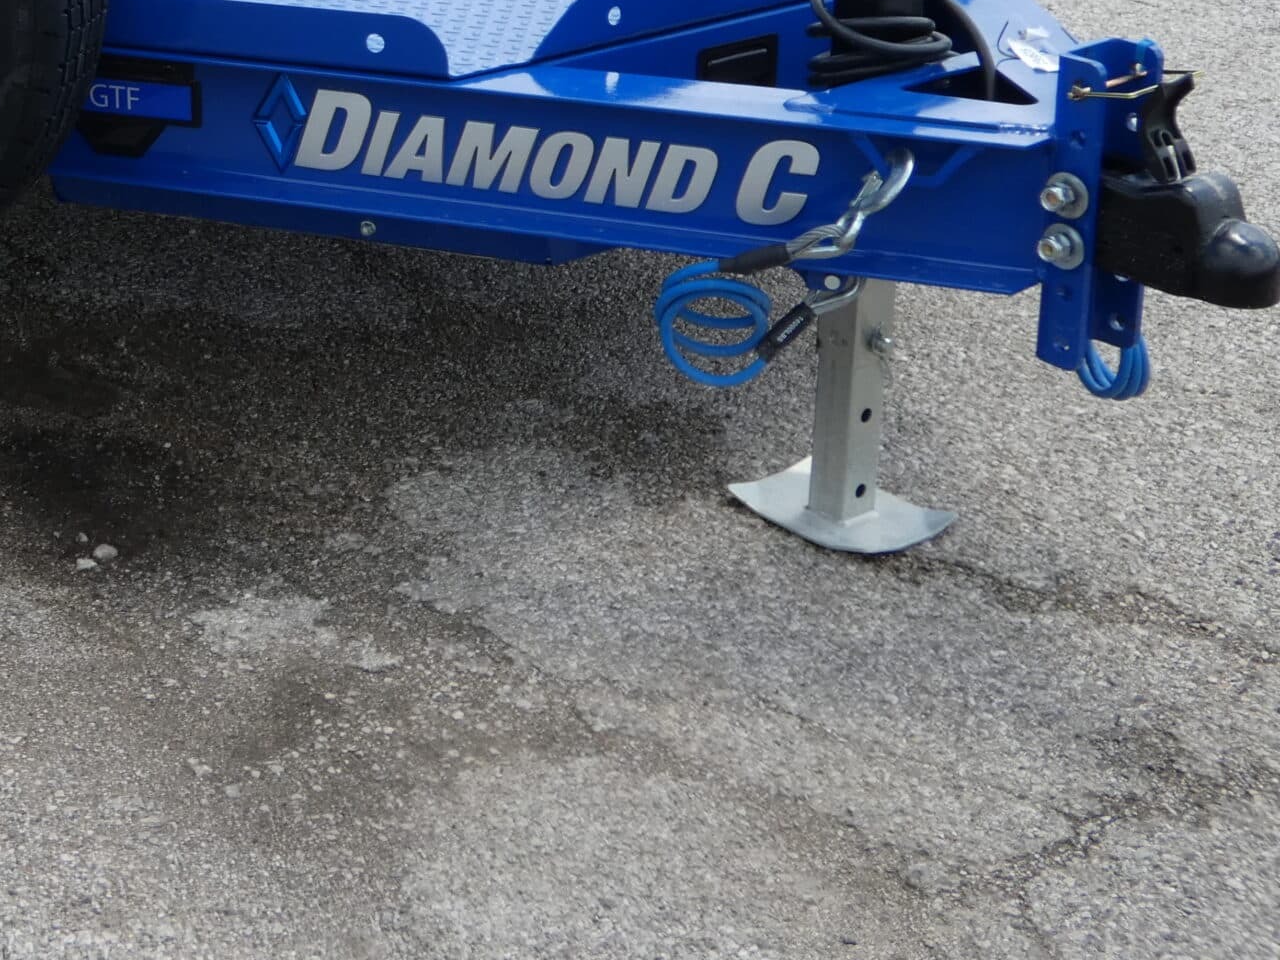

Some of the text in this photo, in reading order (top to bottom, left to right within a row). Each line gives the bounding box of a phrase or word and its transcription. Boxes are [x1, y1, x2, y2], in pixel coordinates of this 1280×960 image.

[89, 83, 140, 110] GTF
[294, 88, 821, 227] DIAMOND C
